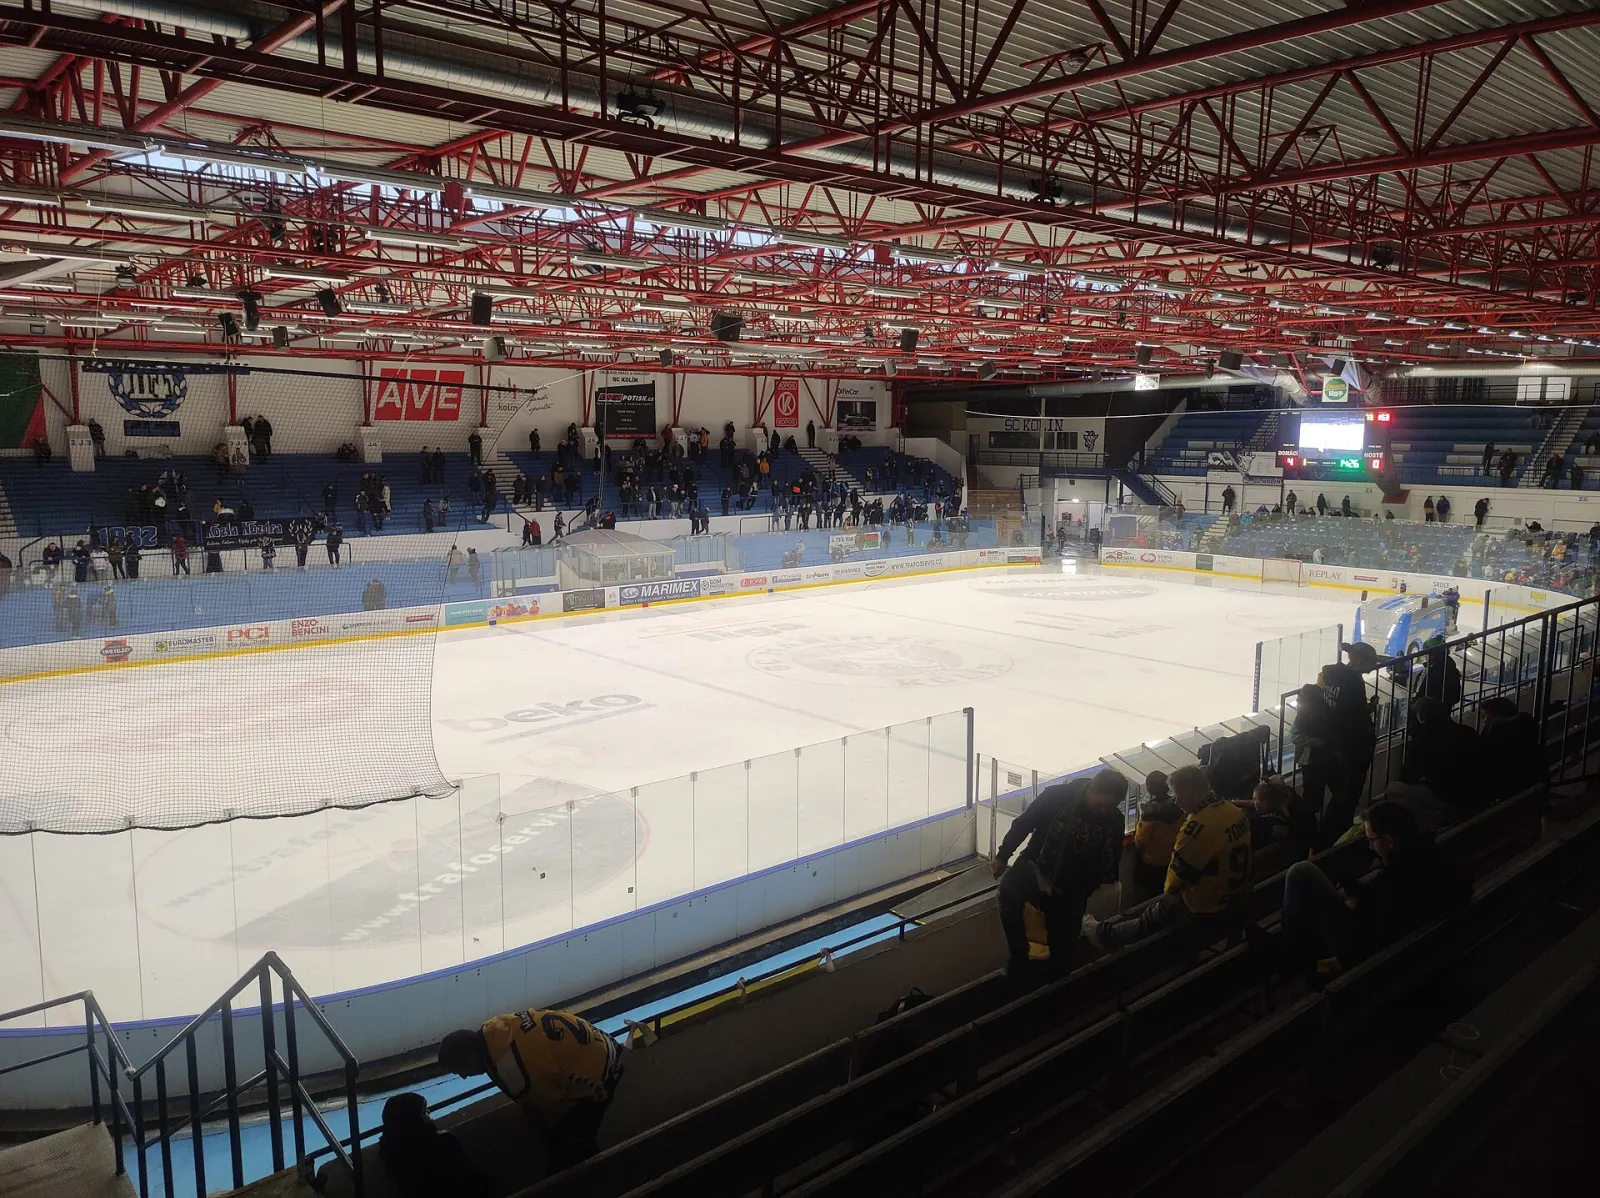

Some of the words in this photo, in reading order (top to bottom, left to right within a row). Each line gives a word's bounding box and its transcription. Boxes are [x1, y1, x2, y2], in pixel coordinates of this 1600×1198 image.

[377, 379, 459, 409] AVE
[1004, 418, 1020, 431] SC
[98, 525, 158, 548] 1932
[890, 558, 943, 570] WWW.TRAFOSERVIS.CZ
[1309, 569, 1342, 580] REPLAY
[641, 580, 698, 597] MARIMEX
[227, 626, 269, 642] PCI
[291, 625, 329, 637] BENCINI
[169, 636, 214, 647] EUROMASTER
[436, 693, 643, 733] beko
[540, 1012, 591, 1046] 2
